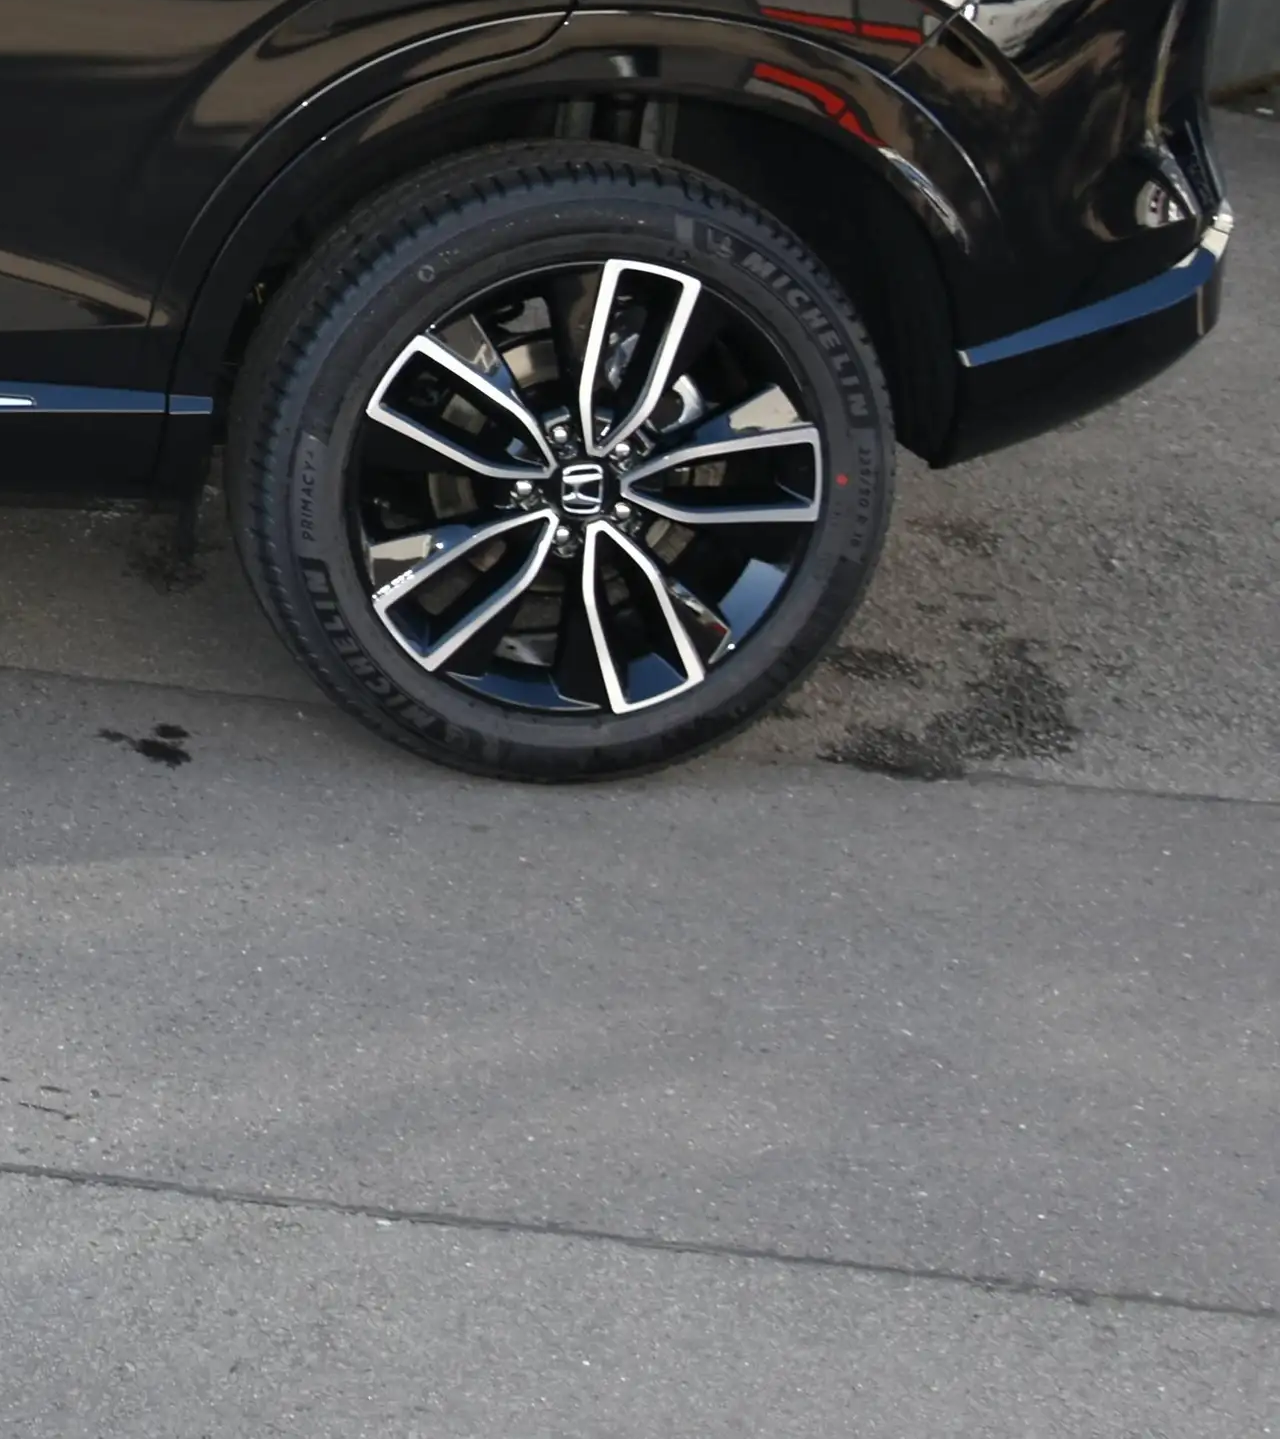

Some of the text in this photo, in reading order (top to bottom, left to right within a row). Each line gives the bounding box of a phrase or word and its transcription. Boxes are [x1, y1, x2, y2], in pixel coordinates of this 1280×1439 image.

[742, 250, 869, 417] MICHELIN
[300, 460, 317, 542] PRIMACY
[303, 569, 437, 728] MICHELIN
